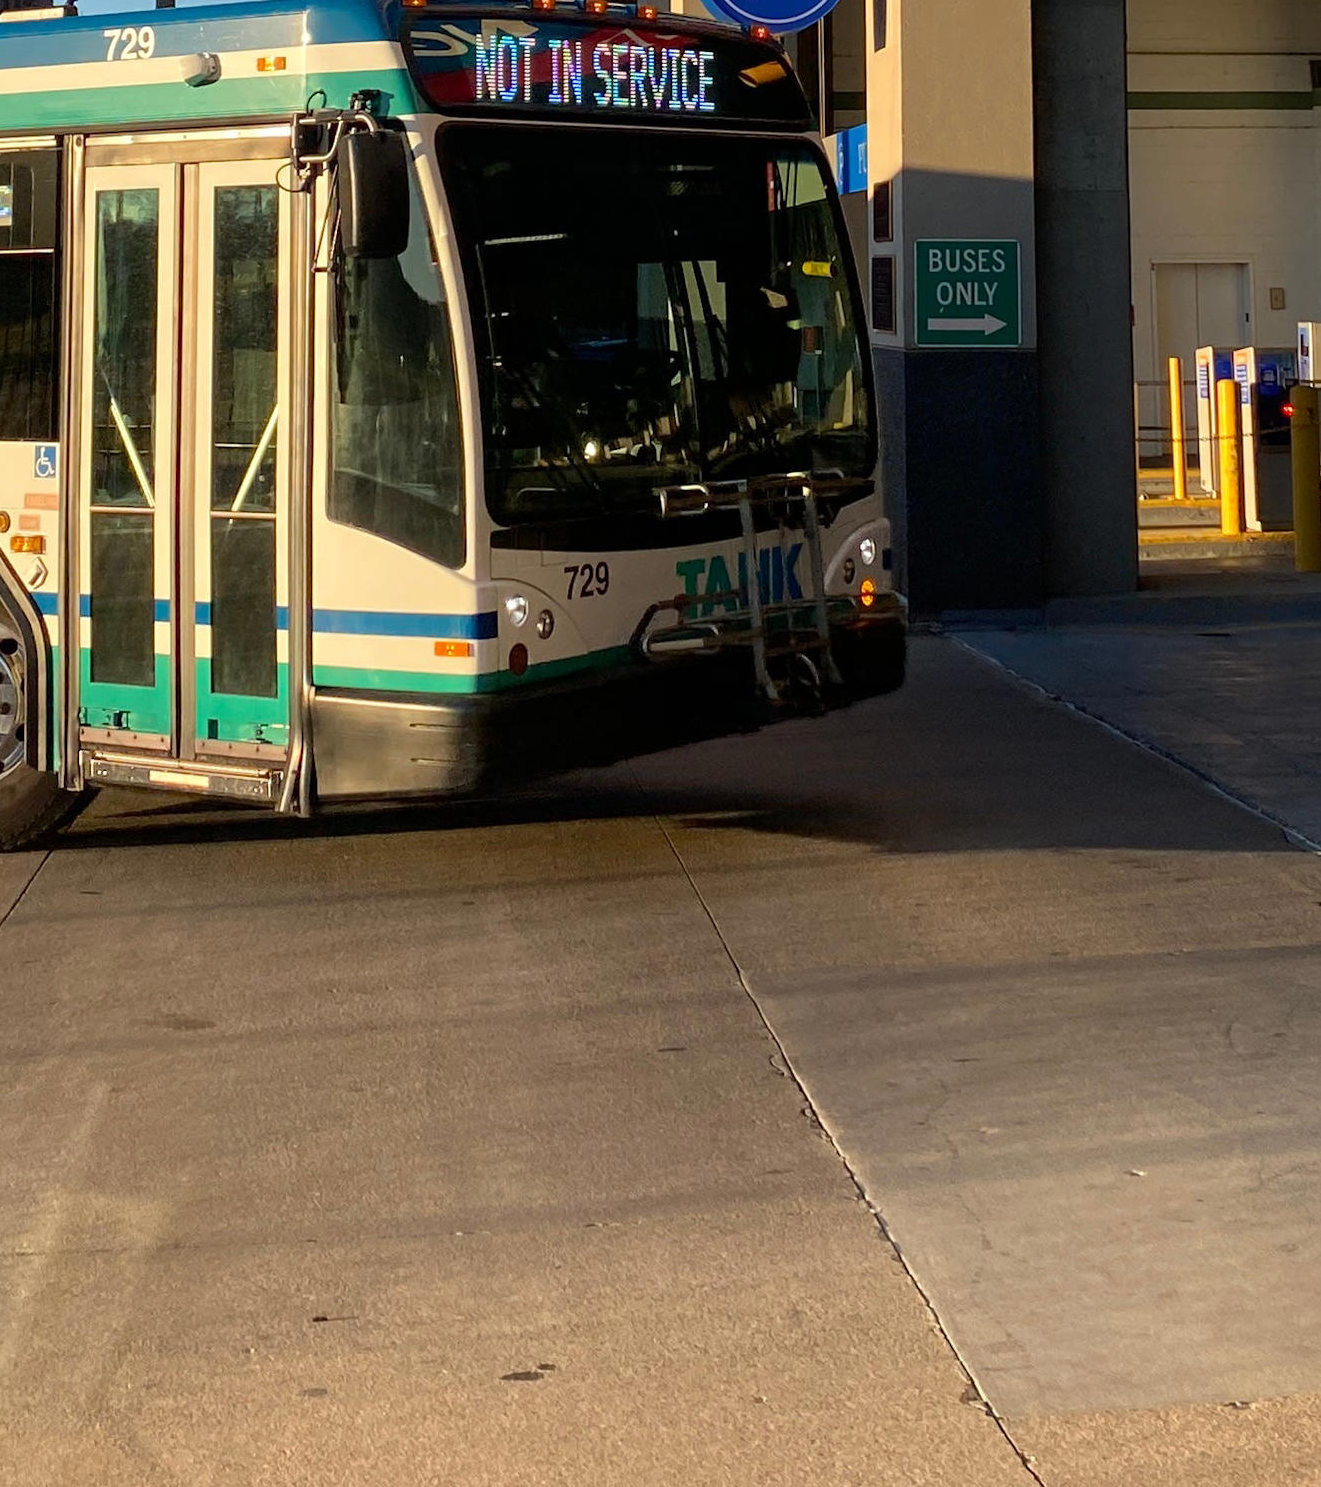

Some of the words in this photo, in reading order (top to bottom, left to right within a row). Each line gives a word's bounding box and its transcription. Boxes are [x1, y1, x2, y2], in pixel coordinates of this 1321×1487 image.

[104, 26, 155, 61] 729
[475, 33, 536, 104] NOT
[548, 39, 582, 104] IN
[593, 42, 716, 111] SERVICE
[928, 249, 1007, 273] BUSES
[936, 281, 999, 306] ONLY
[564, 561, 610, 600] 729
